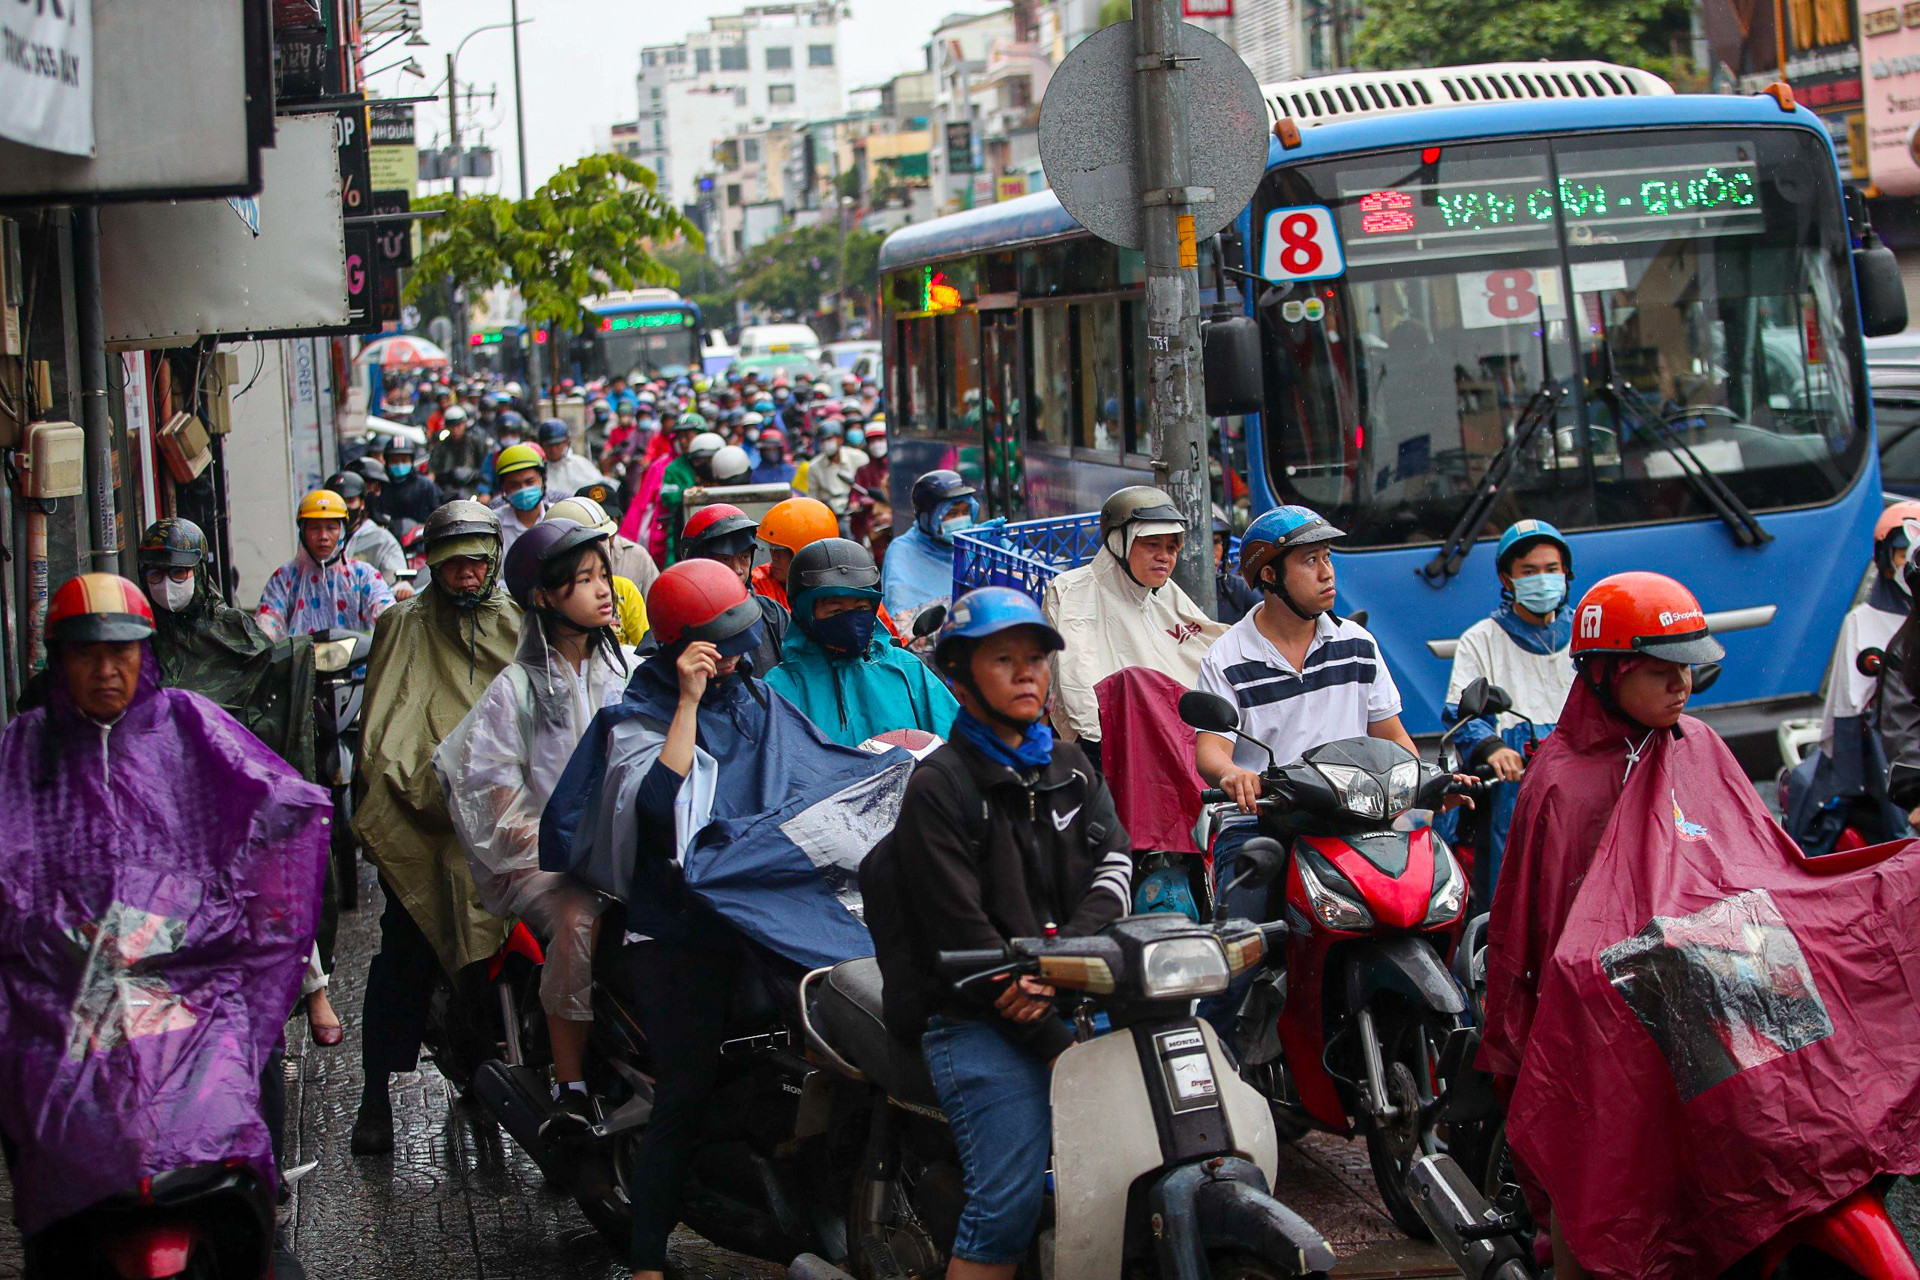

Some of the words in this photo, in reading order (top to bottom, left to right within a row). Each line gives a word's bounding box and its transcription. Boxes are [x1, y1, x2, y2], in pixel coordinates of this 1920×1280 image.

[1280, 213, 1323, 274] 8
[1485, 268, 1538, 319] 8
[1361, 830, 1398, 841] HONDA
[1169, 1037, 1201, 1048] HONDA
